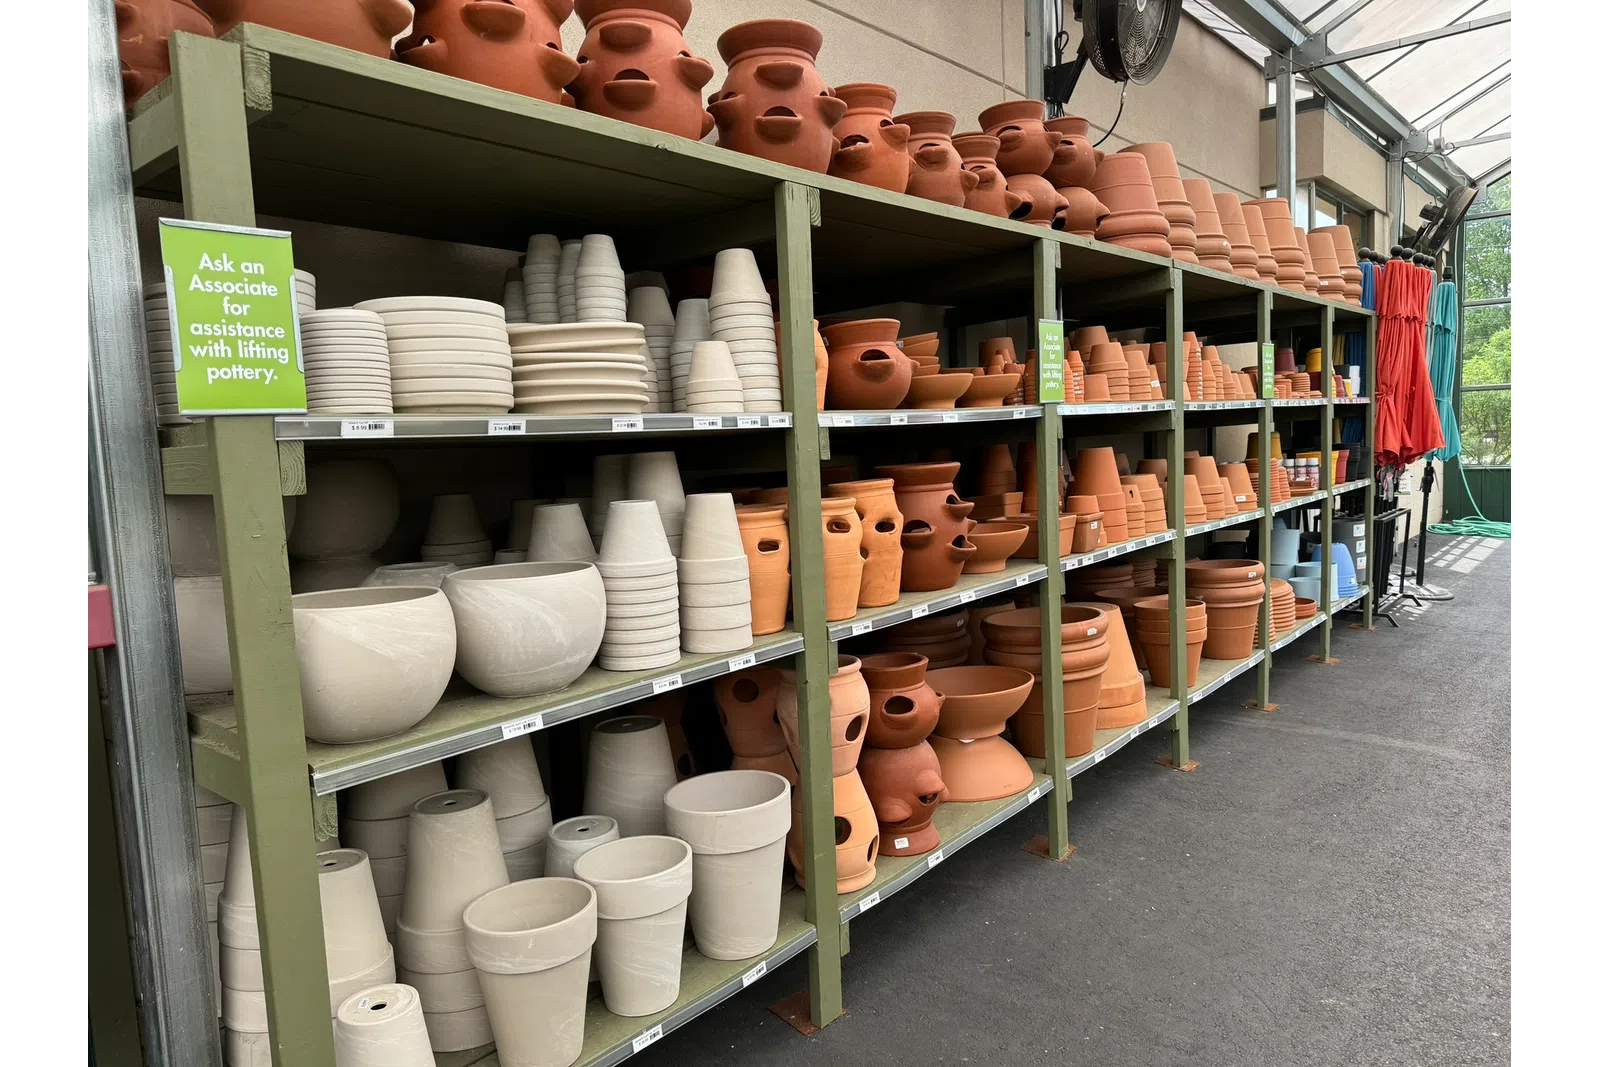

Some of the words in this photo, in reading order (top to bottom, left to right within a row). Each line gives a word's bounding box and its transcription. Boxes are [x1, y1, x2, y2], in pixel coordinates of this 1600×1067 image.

[199, 253, 235, 272] Ask
[241, 261, 264, 275] an
[189, 274, 278, 296] Associate
[223, 296, 250, 315] for
[190, 319, 285, 338] assistance
[189, 339, 232, 358] with
[238, 340, 289, 364] lifting
[207, 365, 278, 384] pottery.
